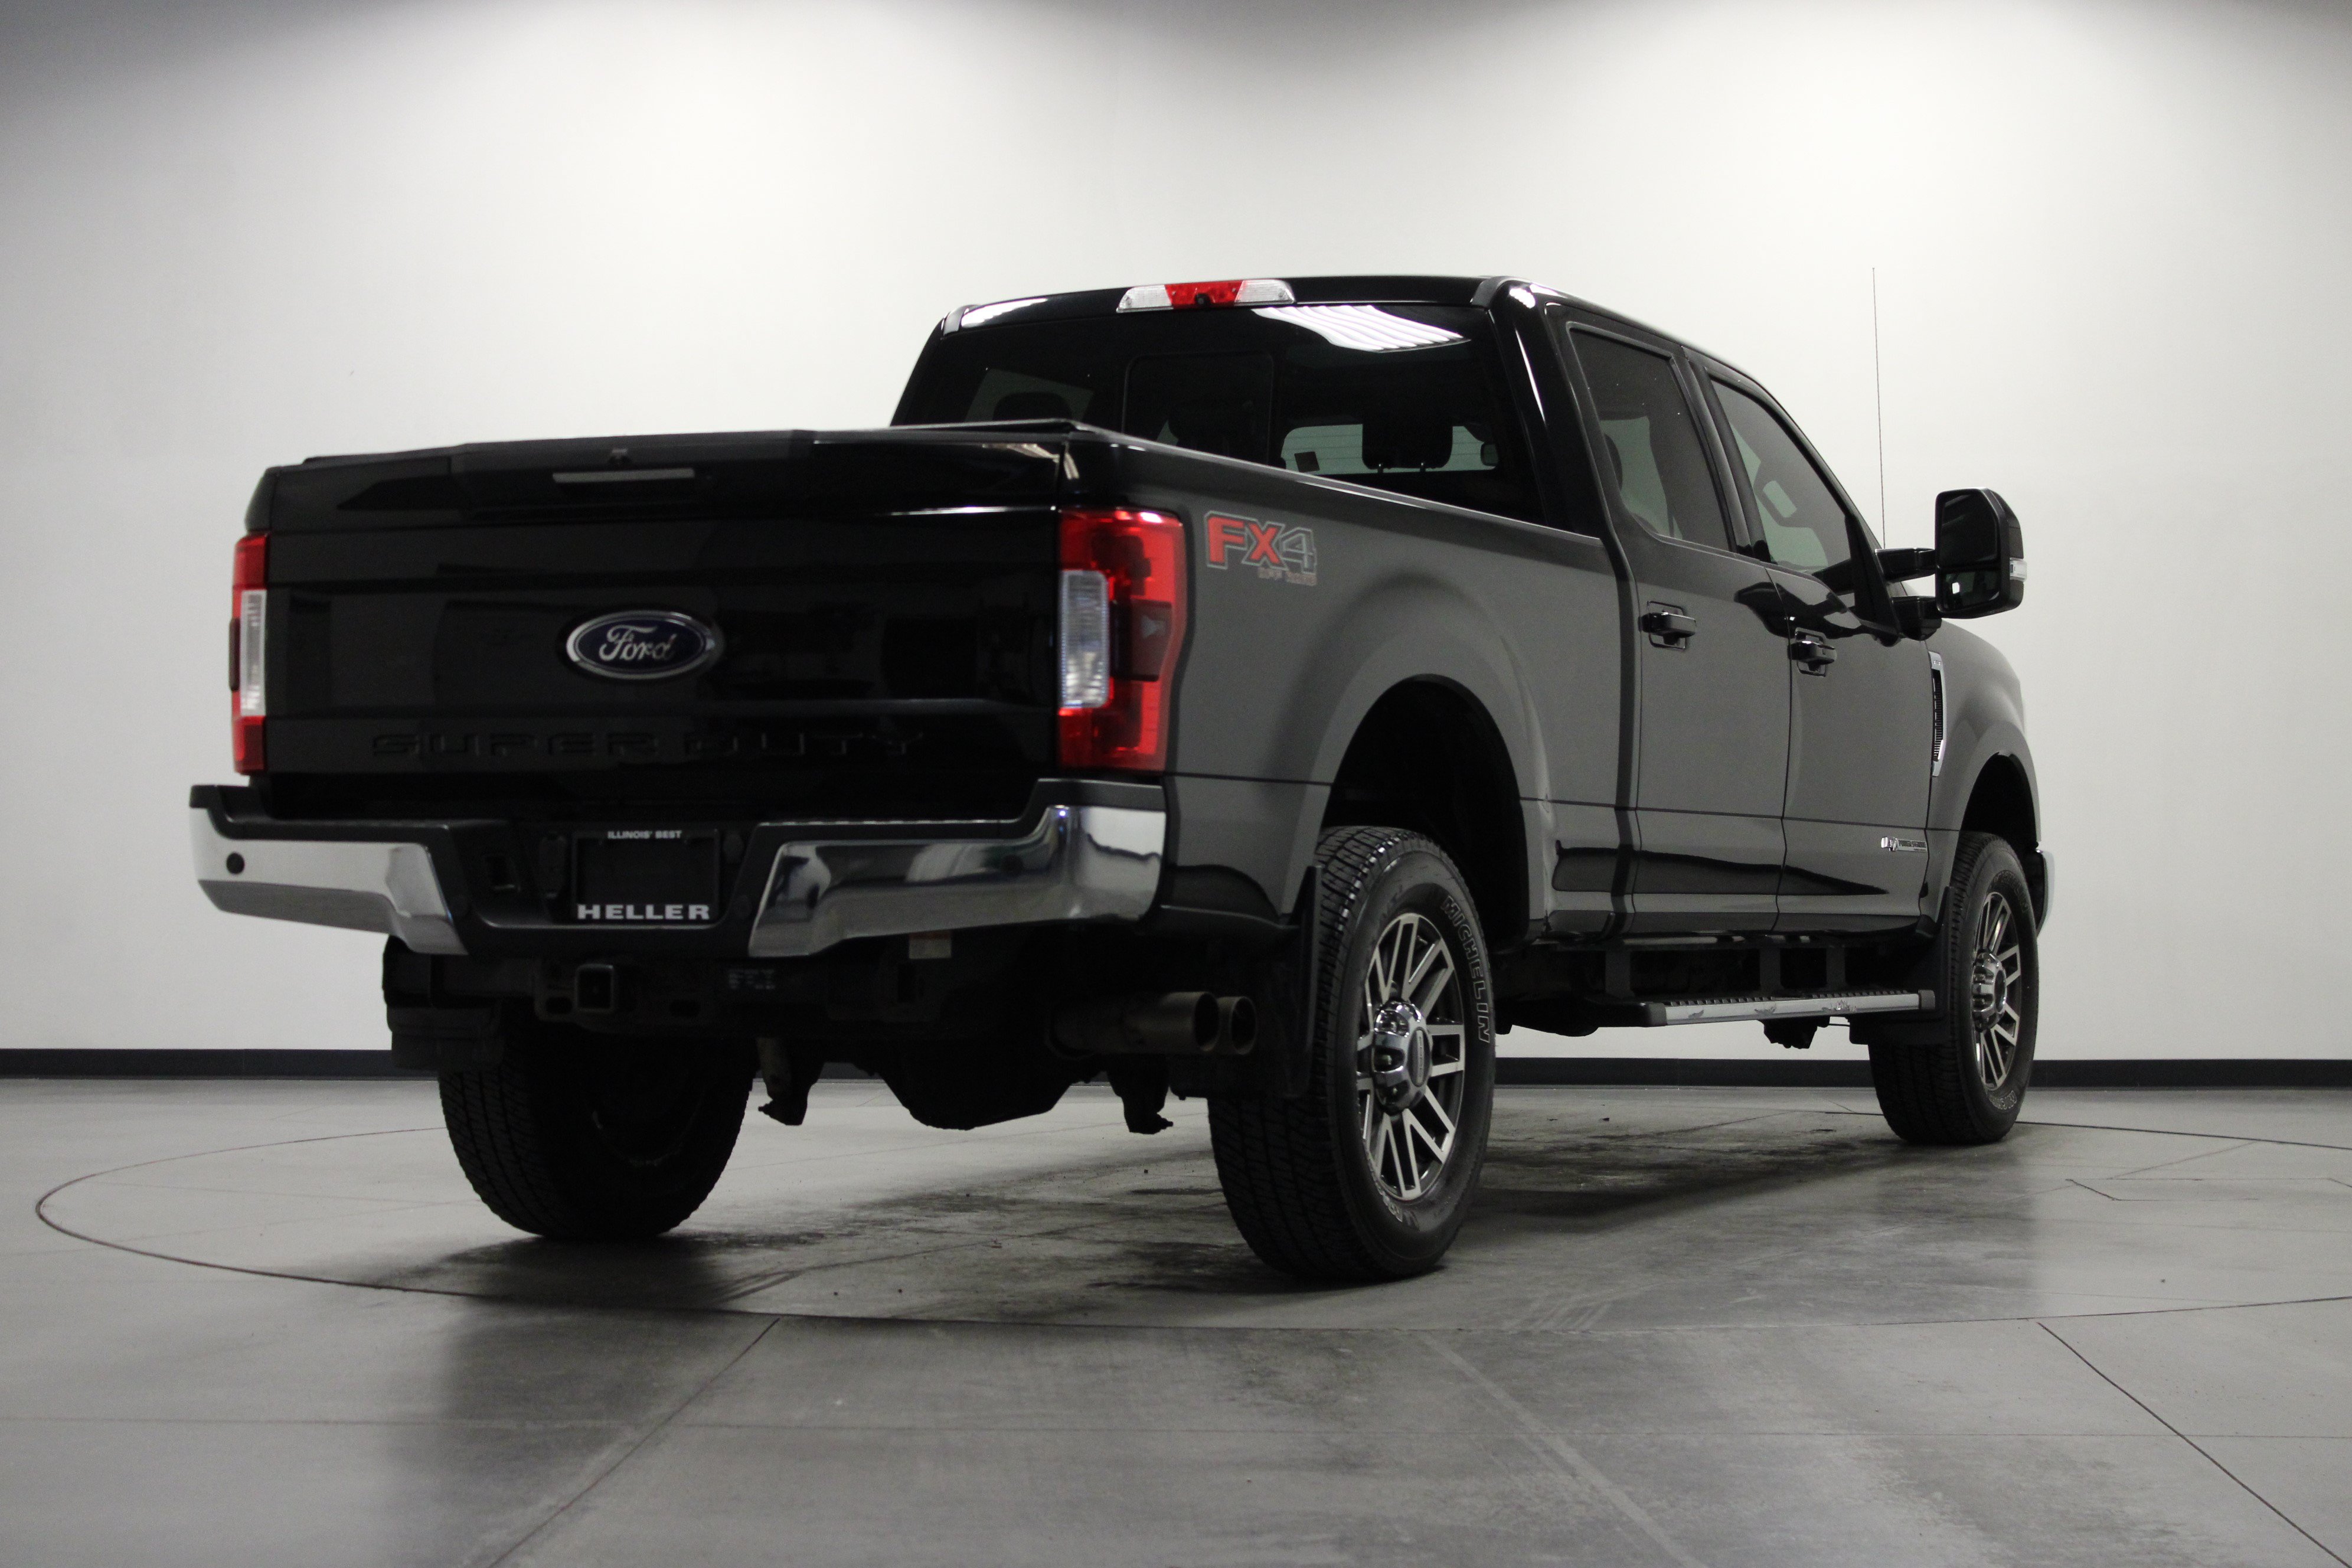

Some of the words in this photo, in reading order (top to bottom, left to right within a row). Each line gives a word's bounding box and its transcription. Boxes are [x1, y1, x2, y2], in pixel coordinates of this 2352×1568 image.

[1204, 510, 1317, 574] FX4
[599, 624, 678, 662] Ford
[372, 732, 659, 757] SUPER
[684, 731, 925, 757] DUTY
[655, 829, 682, 839] BEST
[577, 904, 710, 920] HELLER
[1440, 895, 1490, 1043] MICHELIN
